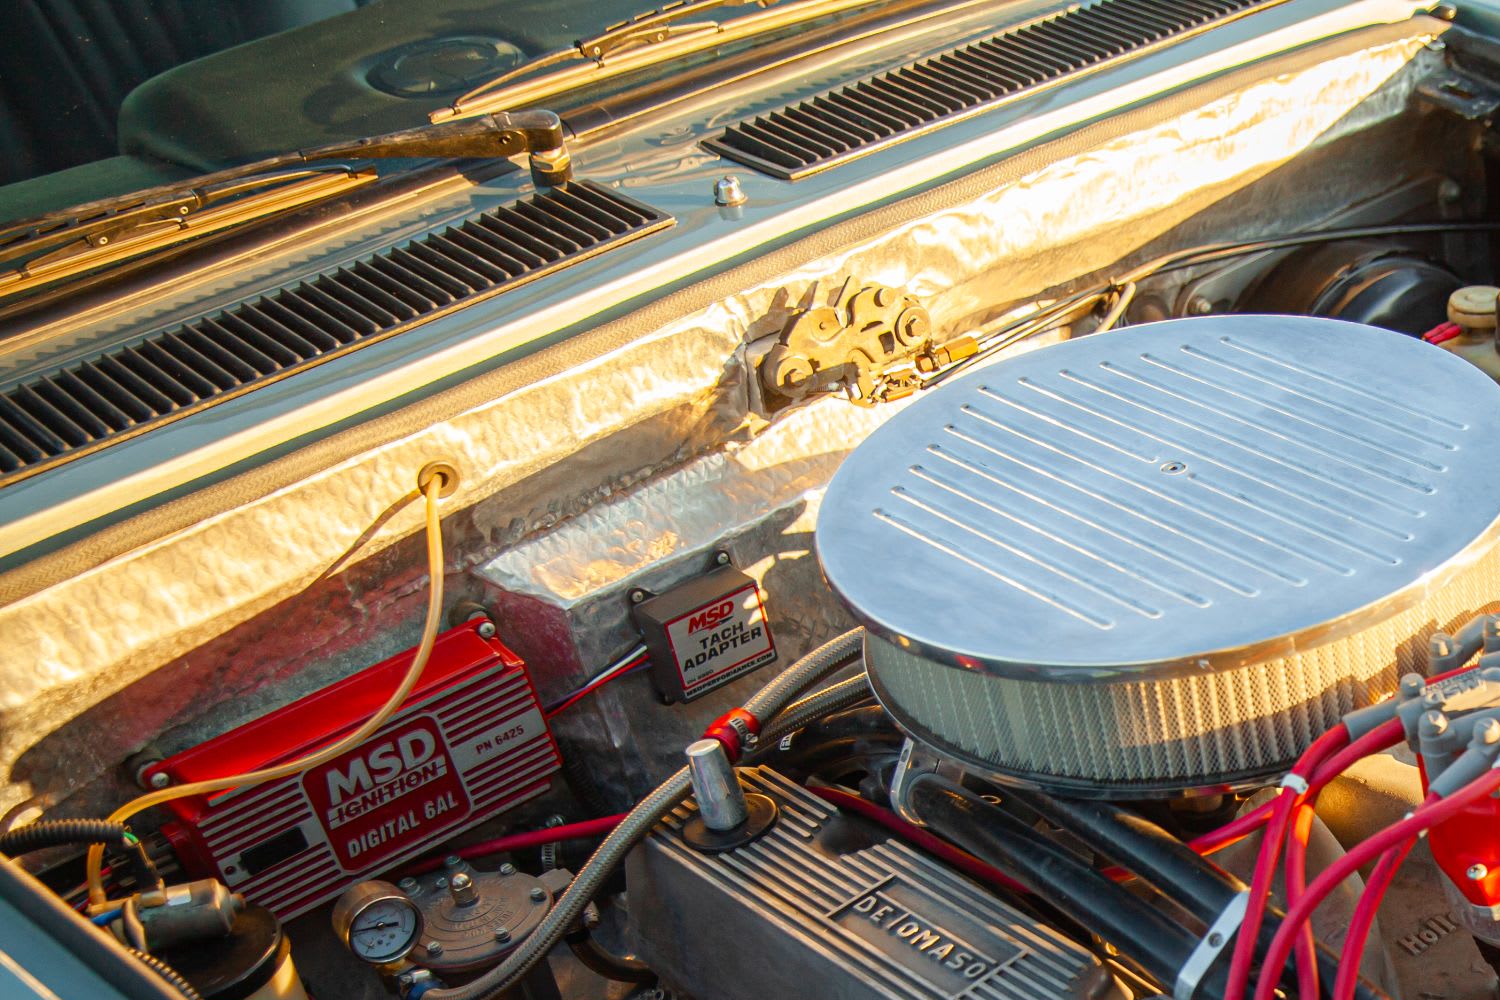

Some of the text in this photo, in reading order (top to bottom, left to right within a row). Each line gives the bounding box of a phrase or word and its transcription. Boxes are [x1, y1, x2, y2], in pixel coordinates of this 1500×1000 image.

[688, 600, 734, 636] MSD
[699, 620, 744, 650] TACH
[683, 626, 762, 673] ADAPTER
[475, 724, 525, 755] PN 6425
[326, 728, 436, 807] MSD
[336, 760, 439, 823] IGNITION
[346, 790, 459, 858] DIGITAL 6AL
